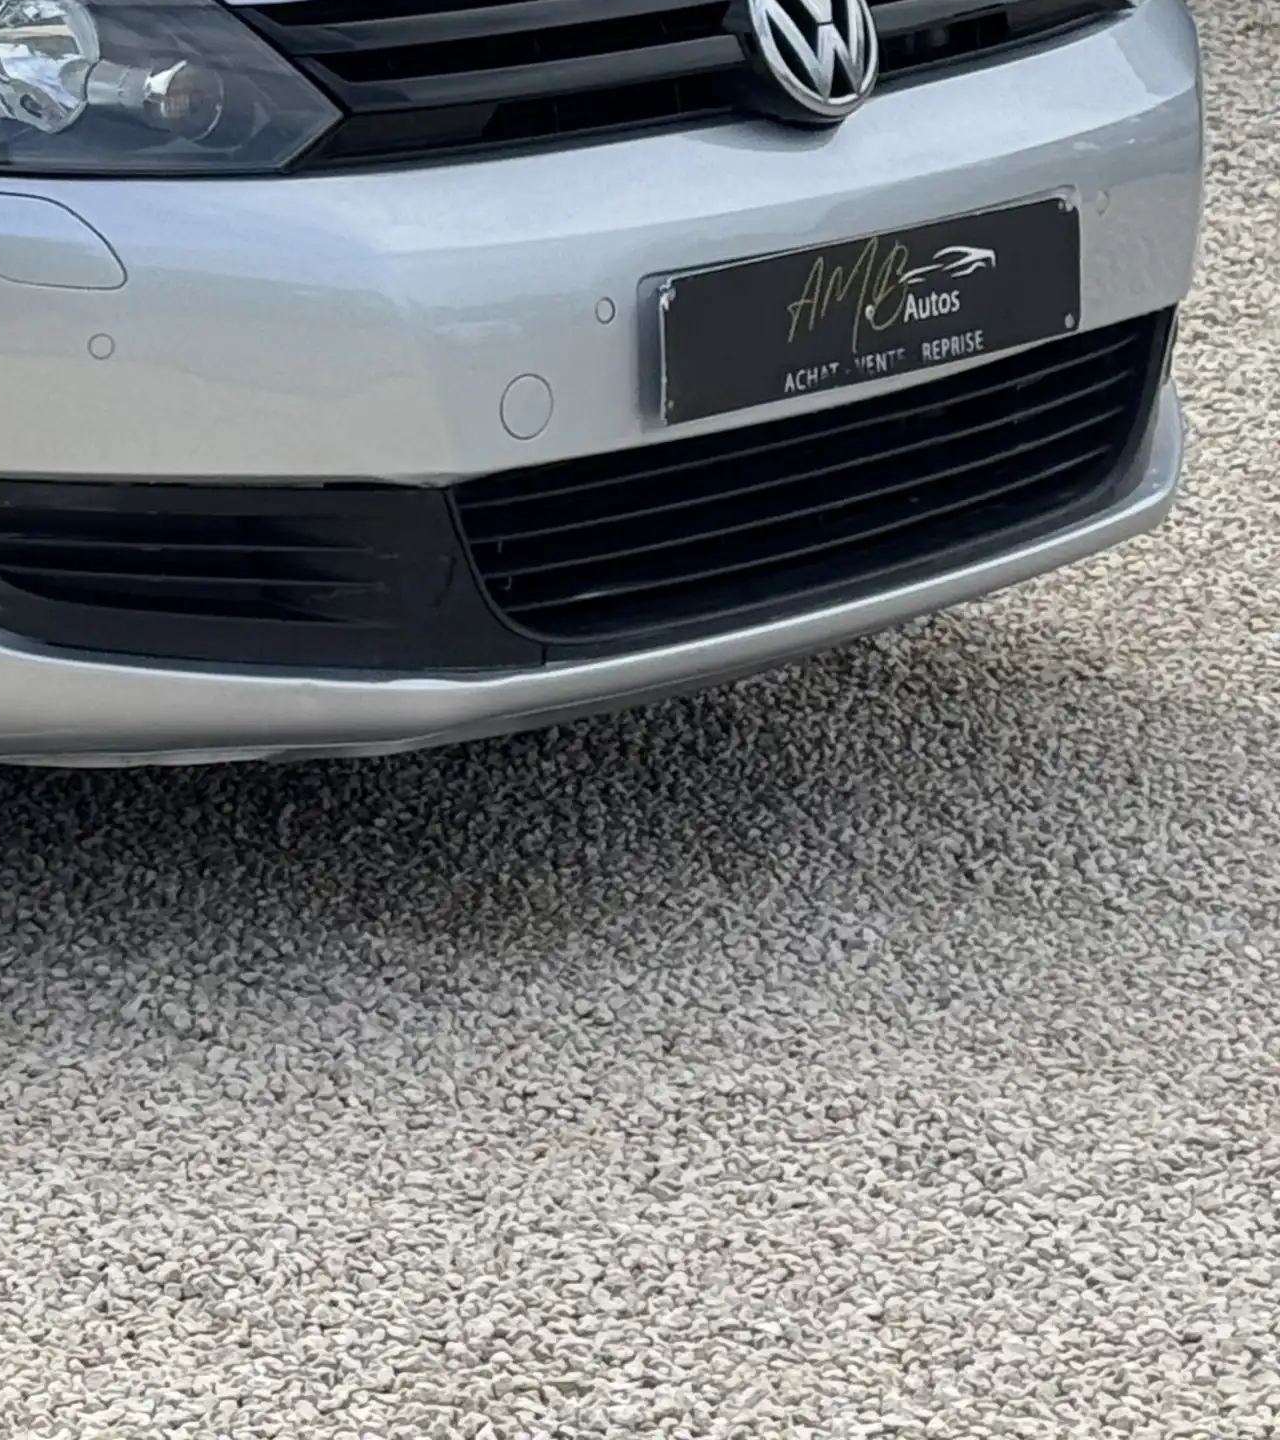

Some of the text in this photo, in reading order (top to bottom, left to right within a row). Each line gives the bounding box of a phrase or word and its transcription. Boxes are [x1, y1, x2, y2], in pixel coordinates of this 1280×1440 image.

[787, 236, 910, 354] AMB
[903, 289, 961, 324] Autos
[784, 361, 840, 393] ACHAT
[921, 329, 985, 365] REPRISE
